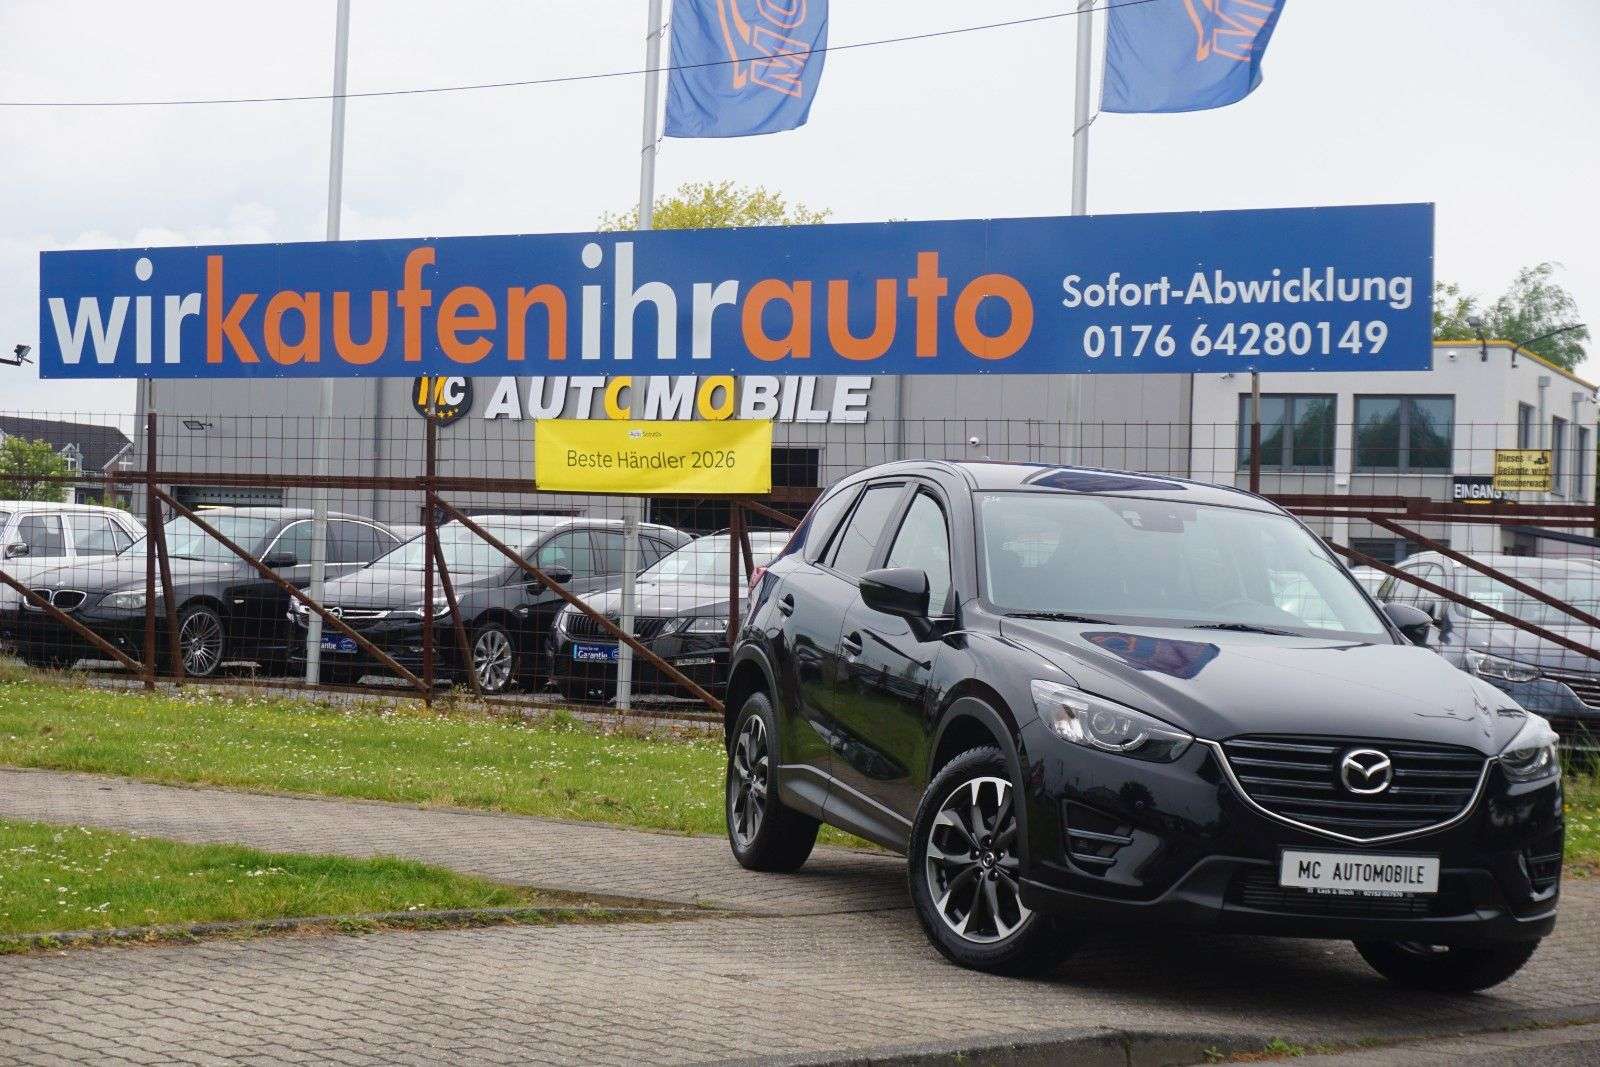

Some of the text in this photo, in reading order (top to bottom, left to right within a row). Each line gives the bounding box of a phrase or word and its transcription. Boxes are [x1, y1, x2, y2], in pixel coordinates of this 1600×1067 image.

[1062, 266, 1413, 310] Sofort-Abwicklung
[1083, 320, 1389, 358] 0176 64280149
[567, 450, 735, 469] Beste Händler 2026
[1298, 860, 1425, 884] MC AUTOMOBILE
